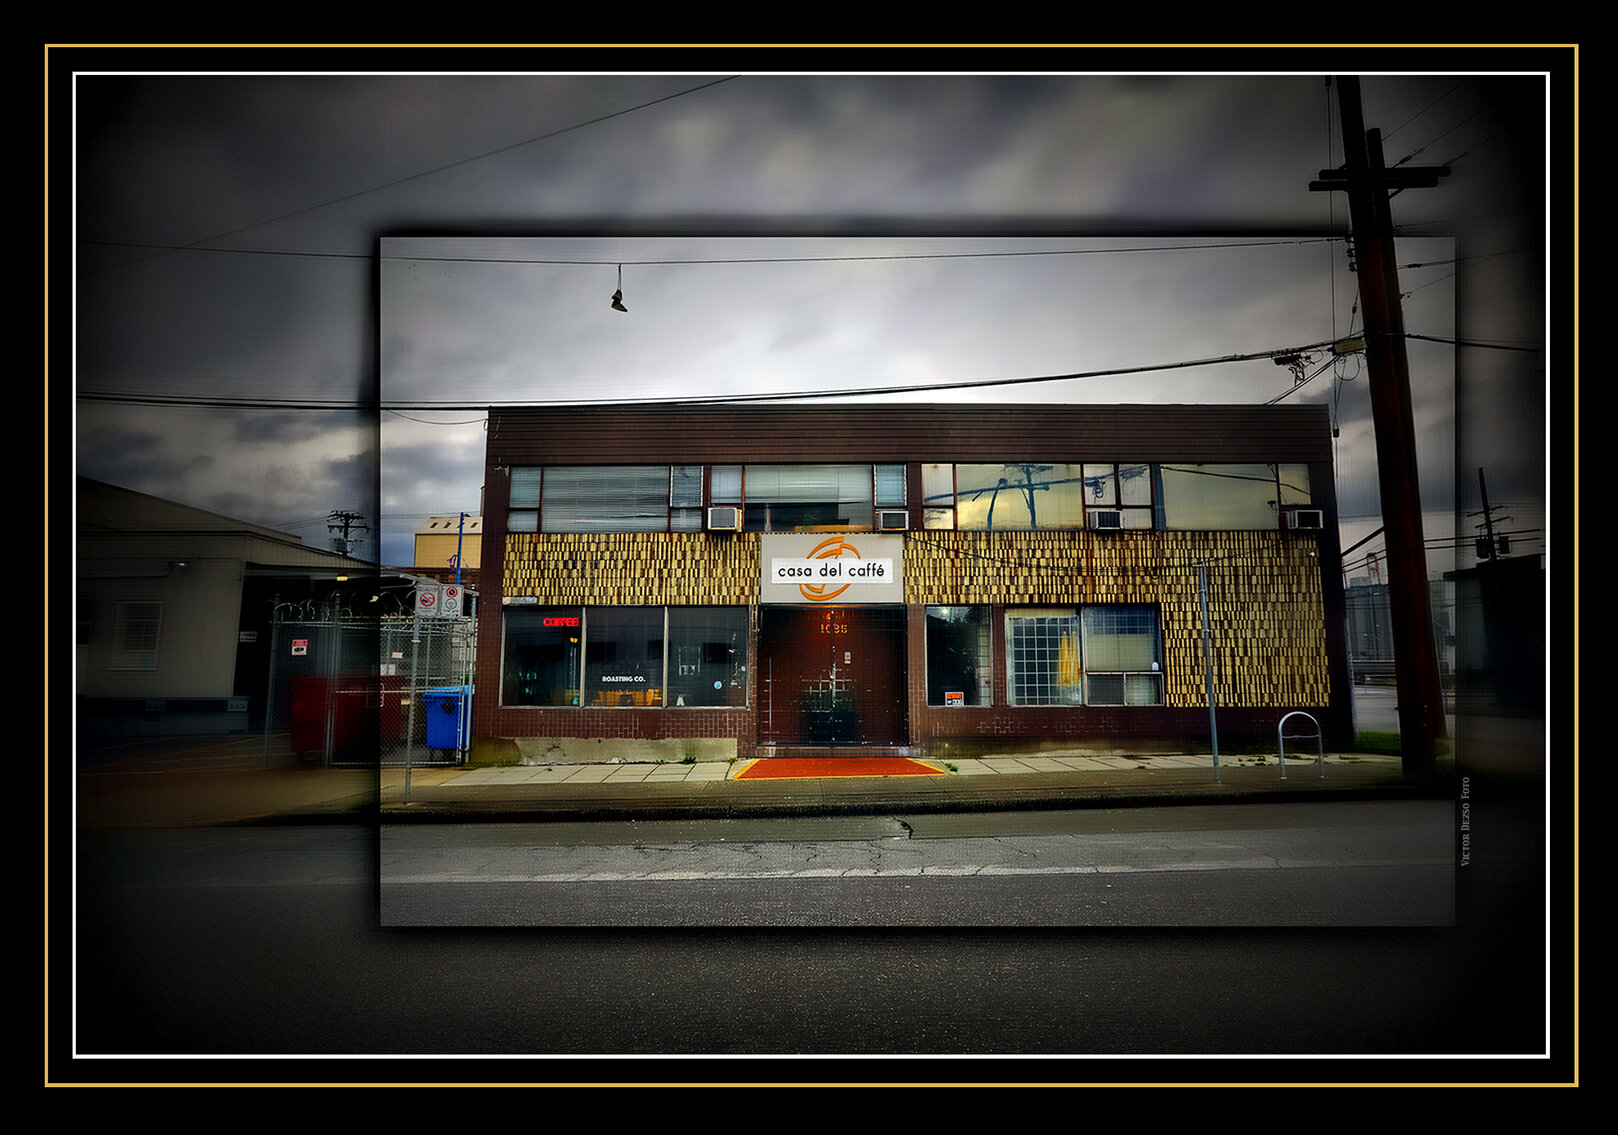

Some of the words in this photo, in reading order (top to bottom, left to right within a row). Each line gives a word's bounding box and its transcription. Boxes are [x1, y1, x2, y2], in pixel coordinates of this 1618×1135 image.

[778, 566, 813, 577] casa
[819, 562, 843, 577] del
[848, 562, 885, 577] caffé
[543, 617, 580, 627] COFFEE
[602, 675, 634, 683] ROASTING
[633, 675, 646, 683] CO.
